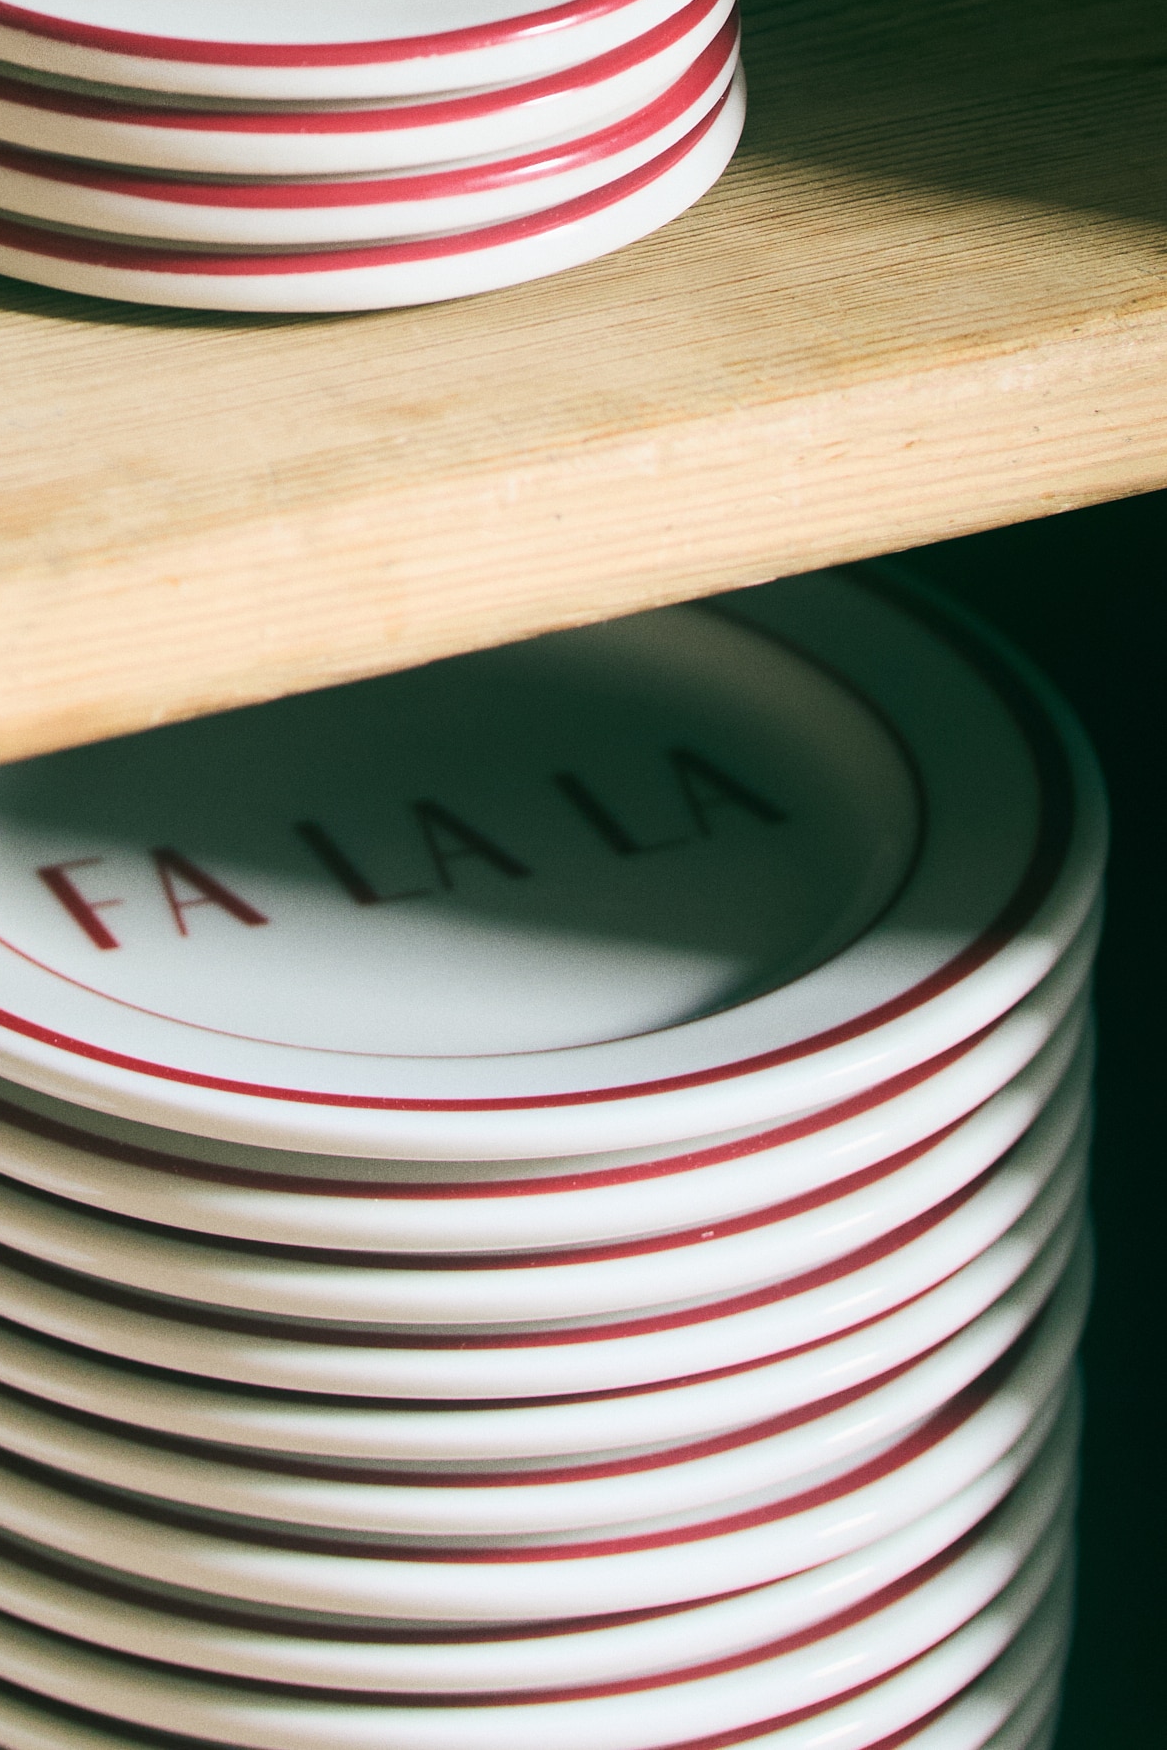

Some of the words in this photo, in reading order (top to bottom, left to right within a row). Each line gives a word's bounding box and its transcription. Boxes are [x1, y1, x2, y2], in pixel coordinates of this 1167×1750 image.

[38, 847, 269, 951] FA
[294, 798, 533, 906] LA
[554, 745, 788, 856] LA
